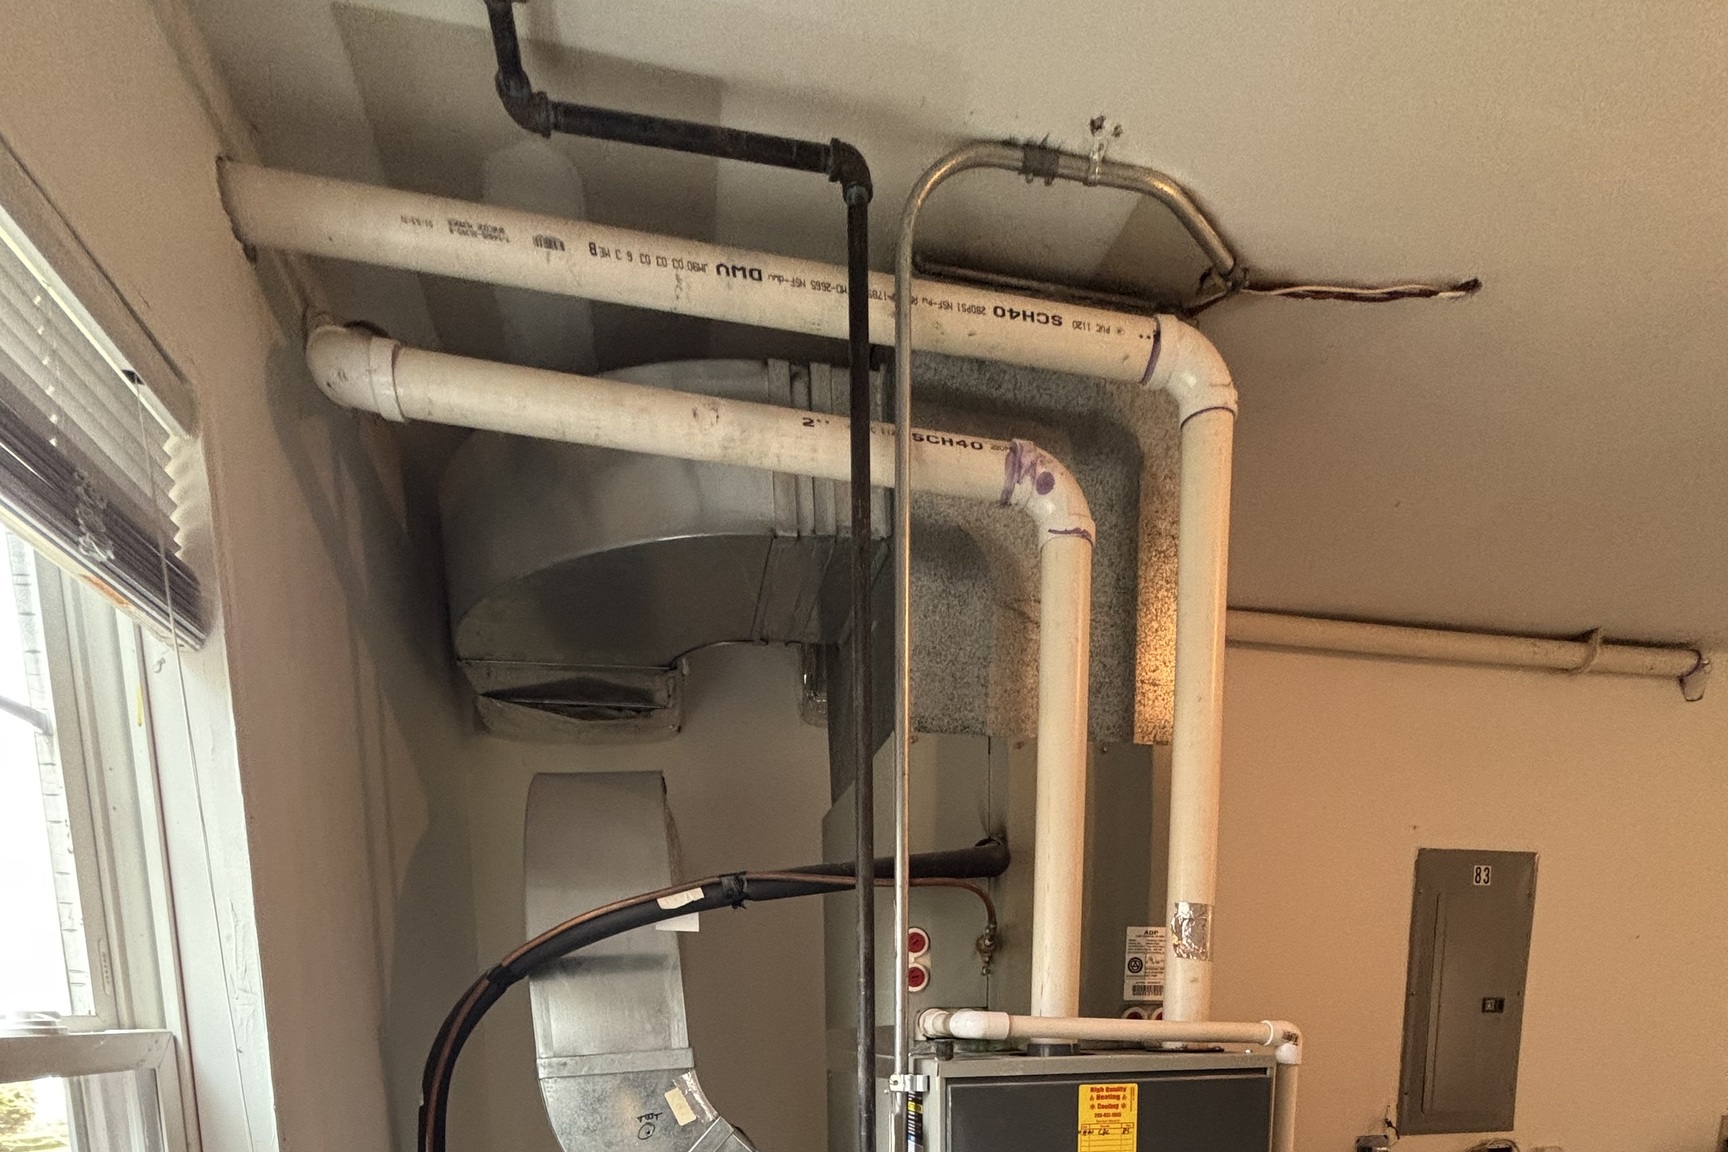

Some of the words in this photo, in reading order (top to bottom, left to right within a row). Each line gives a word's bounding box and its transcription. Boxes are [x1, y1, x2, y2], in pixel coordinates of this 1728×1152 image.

[716, 263, 763, 282] DWV
[993, 306, 1063, 327] SCH40
[1072, 320, 1091, 331] 1120
[912, 433, 984, 450] SCH40
[1474, 866, 1490, 884] 83
